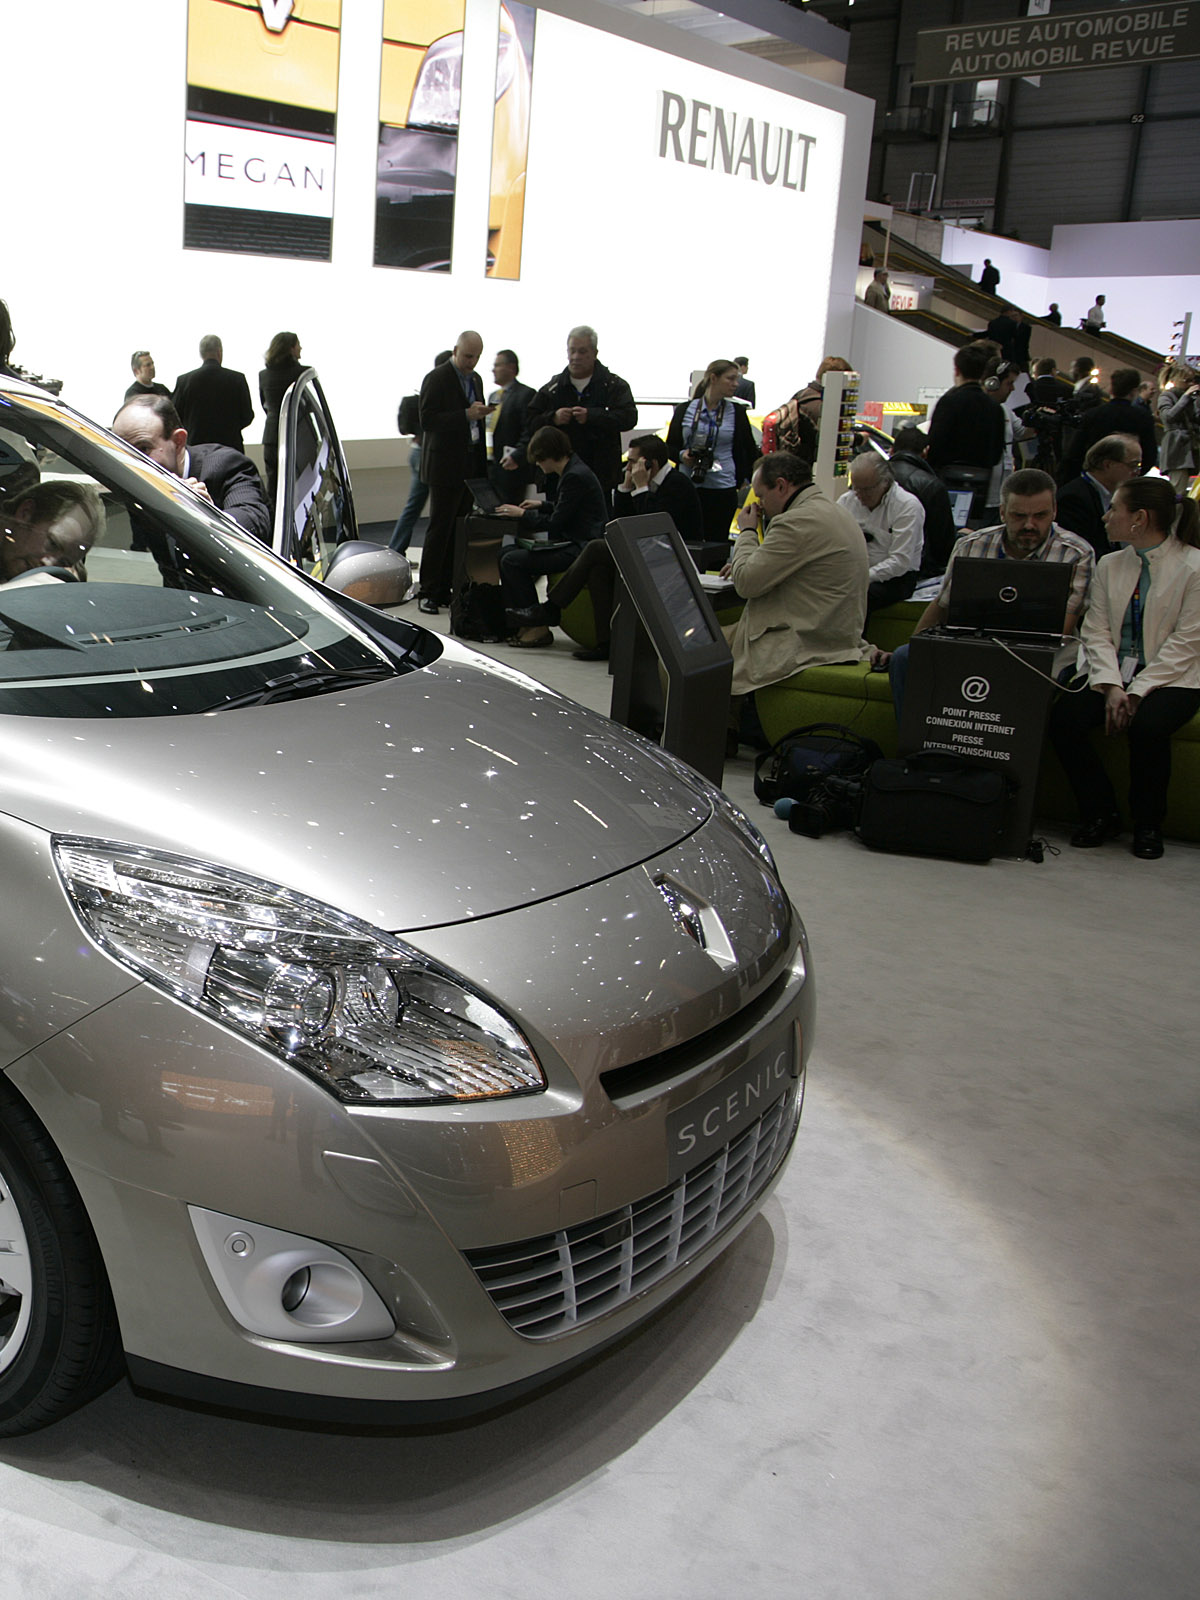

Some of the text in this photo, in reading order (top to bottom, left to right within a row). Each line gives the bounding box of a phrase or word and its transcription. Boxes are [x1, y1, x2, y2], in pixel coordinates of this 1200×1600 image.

[945, 8, 1189, 51] REVUE AUTOMOBILE
[950, 35, 1176, 75] AUTOMOBIL REVUE
[657, 89, 817, 192] RENAULT
[925, 716, 1015, 735] CONNEXION INTERNET
[942, 706, 1001, 722] POINT PRESSE
[952, 733, 984, 746] PRESSE
[677, 1050, 786, 1155] SCENIC
